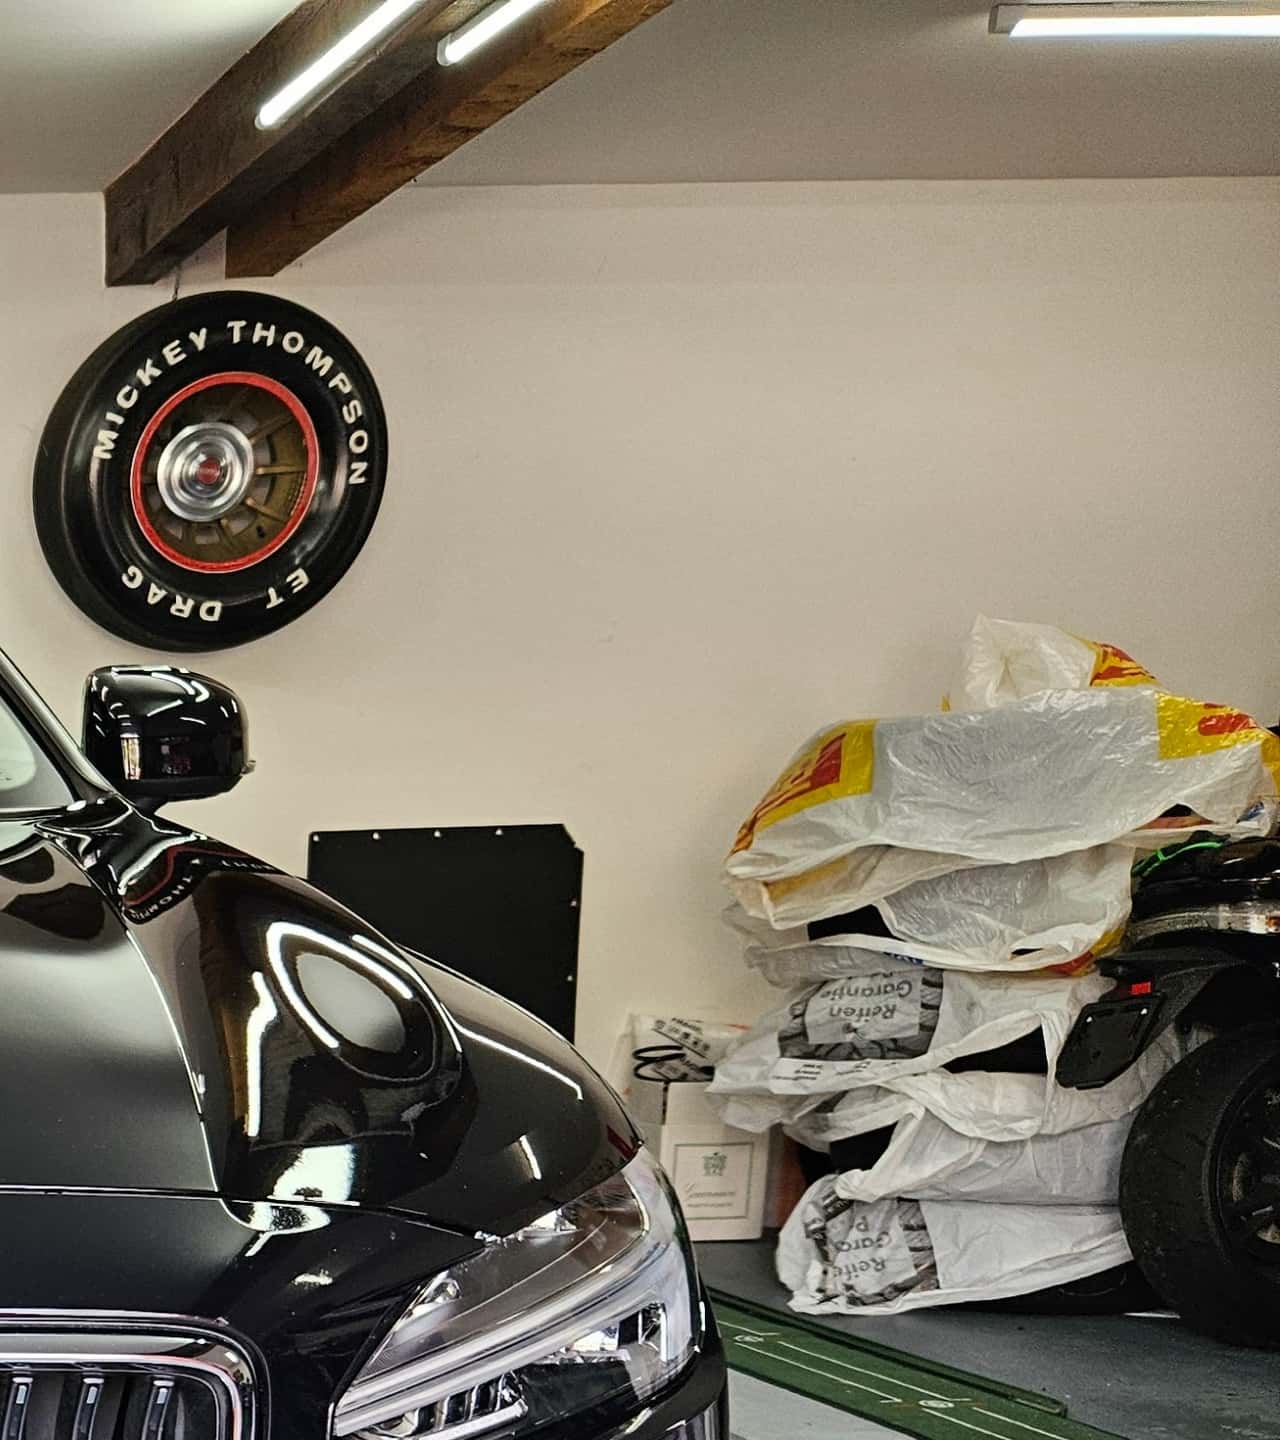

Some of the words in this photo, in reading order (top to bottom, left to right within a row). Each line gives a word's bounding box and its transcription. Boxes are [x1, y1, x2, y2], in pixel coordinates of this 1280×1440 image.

[93, 327, 208, 460] MICKEY
[227, 320, 369, 485] THOMPSON
[121, 566, 223, 622] DRAG
[265, 568, 311, 609] ET
[820, 980, 913, 1001] Garantie
[828, 1004, 897, 1022] Reifen
[832, 1258, 886, 1280] Reife
